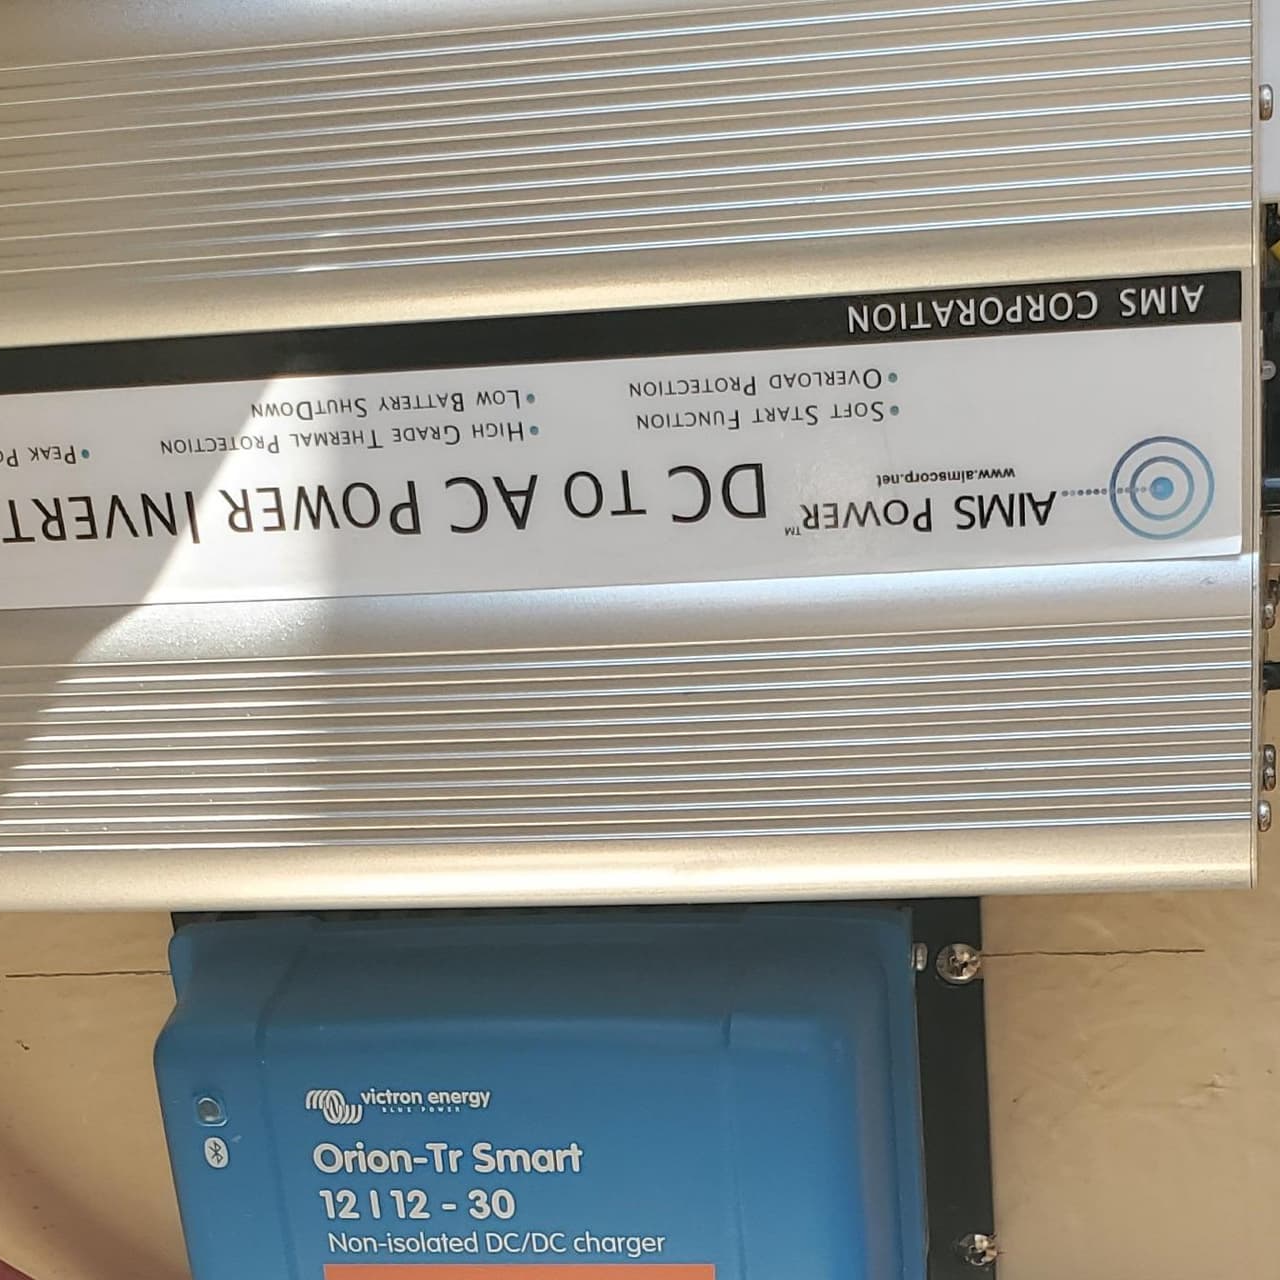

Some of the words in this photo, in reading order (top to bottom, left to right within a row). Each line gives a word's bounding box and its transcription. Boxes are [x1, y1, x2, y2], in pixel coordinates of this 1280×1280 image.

[846, 290, 1098, 334] CORPORATION
[1119, 284, 1205, 317] AIMS
[628, 374, 756, 398] PROTECTION
[769, 368, 883, 390] OVERLOAD
[379, 391, 464, 413] BATTERY
[476, 389, 520, 411] LOW
[830, 400, 884, 423] SOFT
[636, 408, 740, 431] FUNCTION
[752, 405, 818, 427] START
[289, 428, 384, 451] THERMAL
[391, 423, 461, 446] GRADE
[471, 420, 524, 443] HIGH
[27, 444, 77, 466] PEAK
[160, 433, 280, 457] PROTECTION
[876, 467, 1015, 488] www.aimscorp.net
[444, 474, 538, 535] AC
[563, 470, 647, 519] TO
[668, 463, 767, 524] DC
[219, 480, 421, 537] POWER
[954, 491, 1056, 530] AIMS
[361, 1088, 422, 1106] victron
[427, 1090, 490, 1108] energy
[313, 1142, 464, 1174] Orion-Tr
[472, 1143, 583, 1174] Smart
[319, 1190, 360, 1219] 12
[390, 1190, 431, 1219] 12
[468, 1190, 516, 1220] 30
[327, 1231, 479, 1254] Non-isolated
[485, 1232, 567, 1254] DC/DC
[573, 1232, 666, 1258] charger
